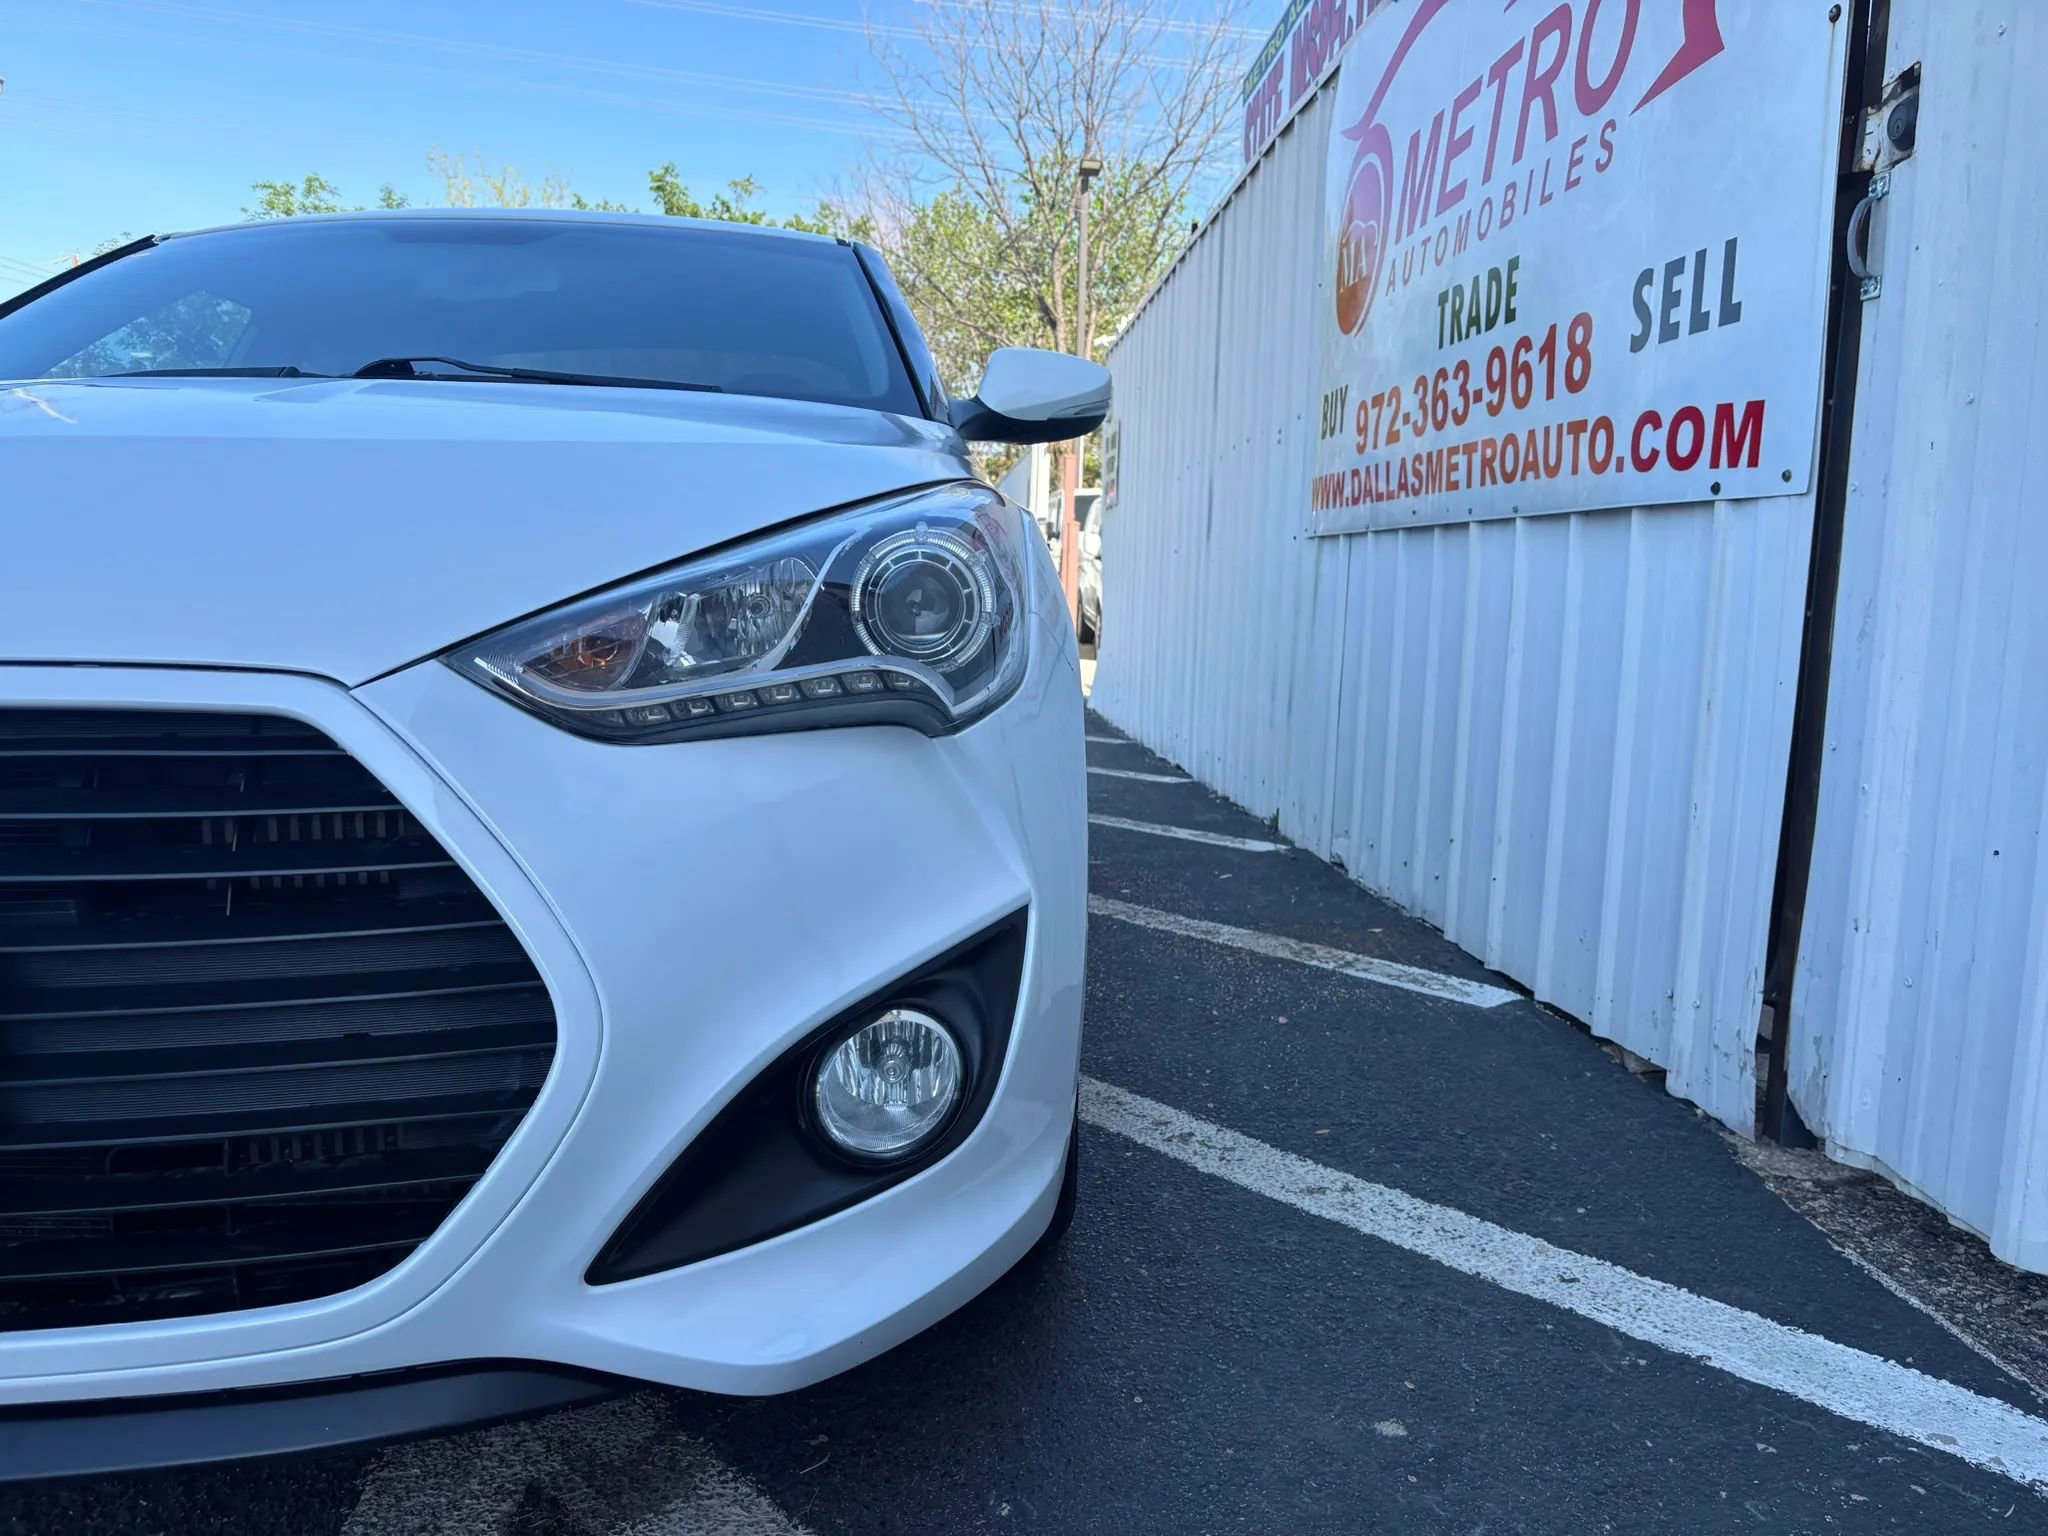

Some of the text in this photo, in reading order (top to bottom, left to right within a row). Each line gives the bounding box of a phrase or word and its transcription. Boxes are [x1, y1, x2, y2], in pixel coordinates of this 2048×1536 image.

[1244, 24, 1285, 94] METRO
[1394, 0, 1641, 246] METRO
[1386, 118, 1618, 297] AUTOMOBILES
[1437, 255, 1520, 350] TRADE
[1629, 236, 1742, 354] SELL
[1320, 384, 1349, 441] BUY
[1355, 311, 1594, 456] 972-363-9618
[1312, 399, 1766, 512] WWW.DALLASMETROAUTO.COM
